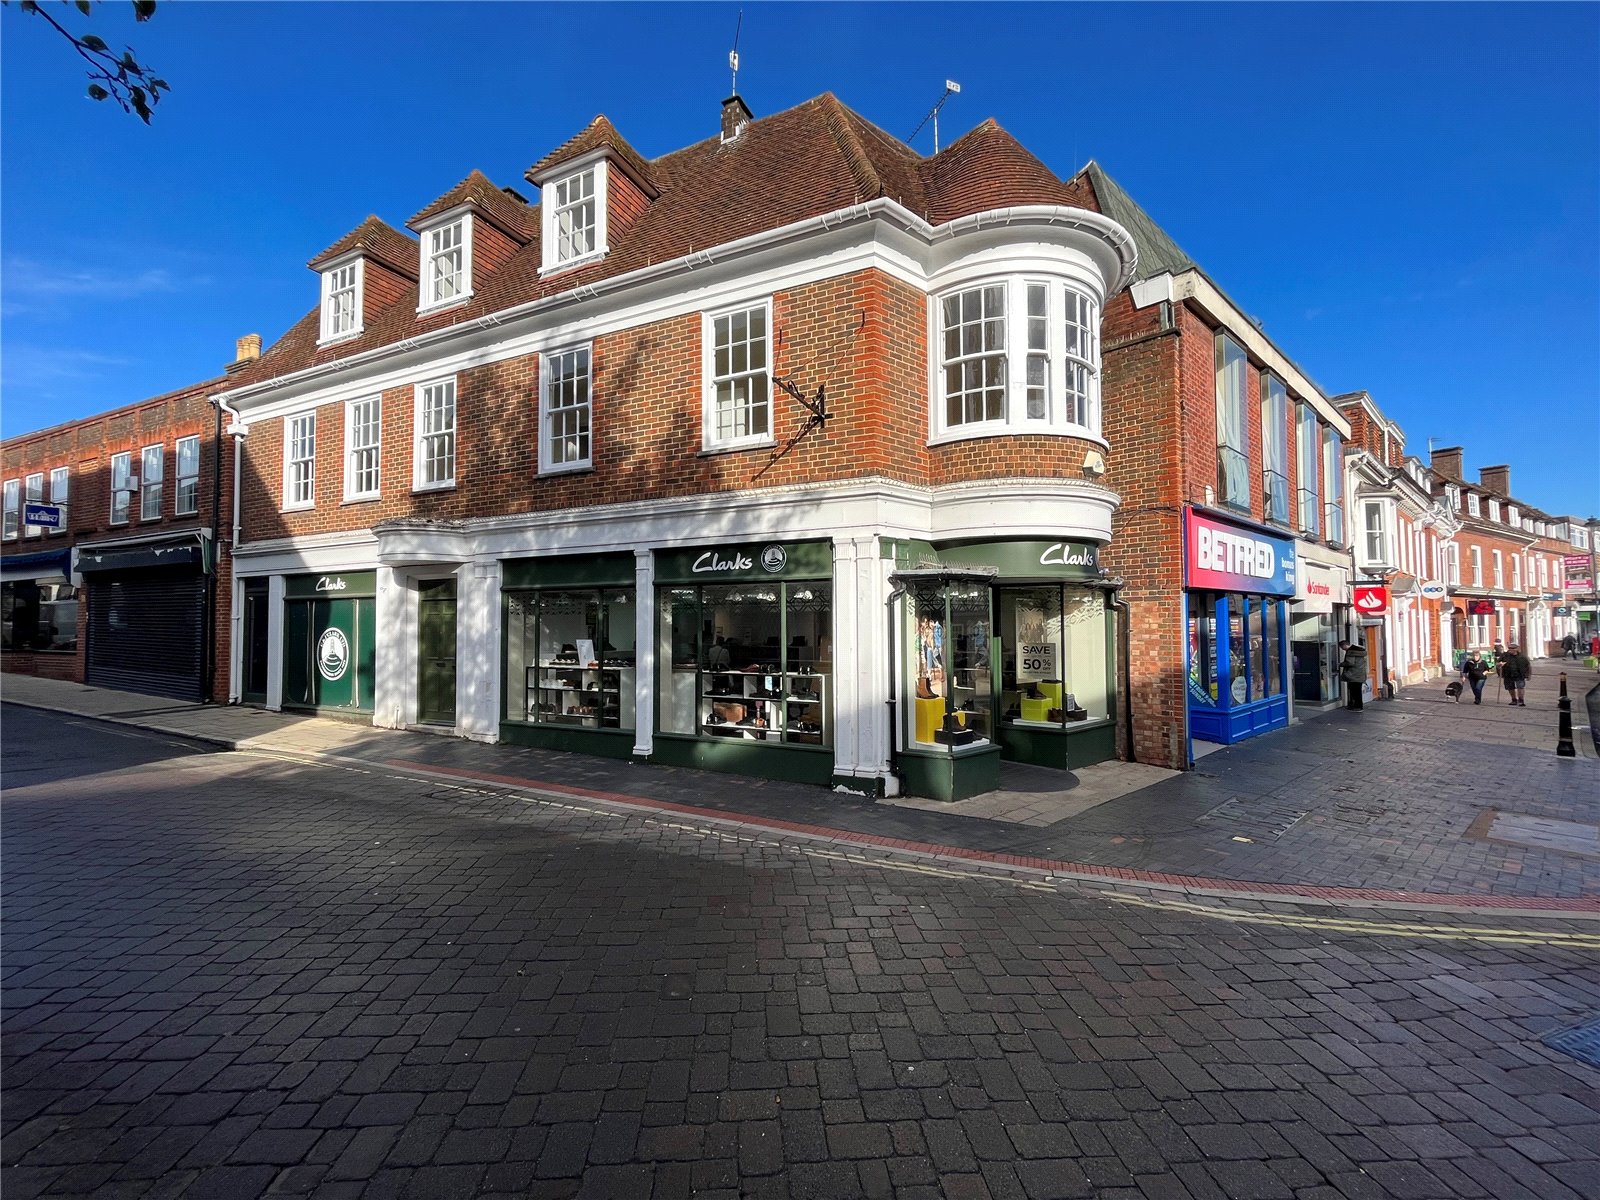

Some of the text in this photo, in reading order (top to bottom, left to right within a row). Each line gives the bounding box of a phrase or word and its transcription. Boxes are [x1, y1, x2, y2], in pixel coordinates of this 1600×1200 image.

[692, 551, 753, 573] Clarks
[1040, 544, 1093, 566] Clarks
[1198, 526, 1274, 578] BETFRED
[315, 576, 347, 592] Clarks
[1022, 645, 1051, 655] SAVE
